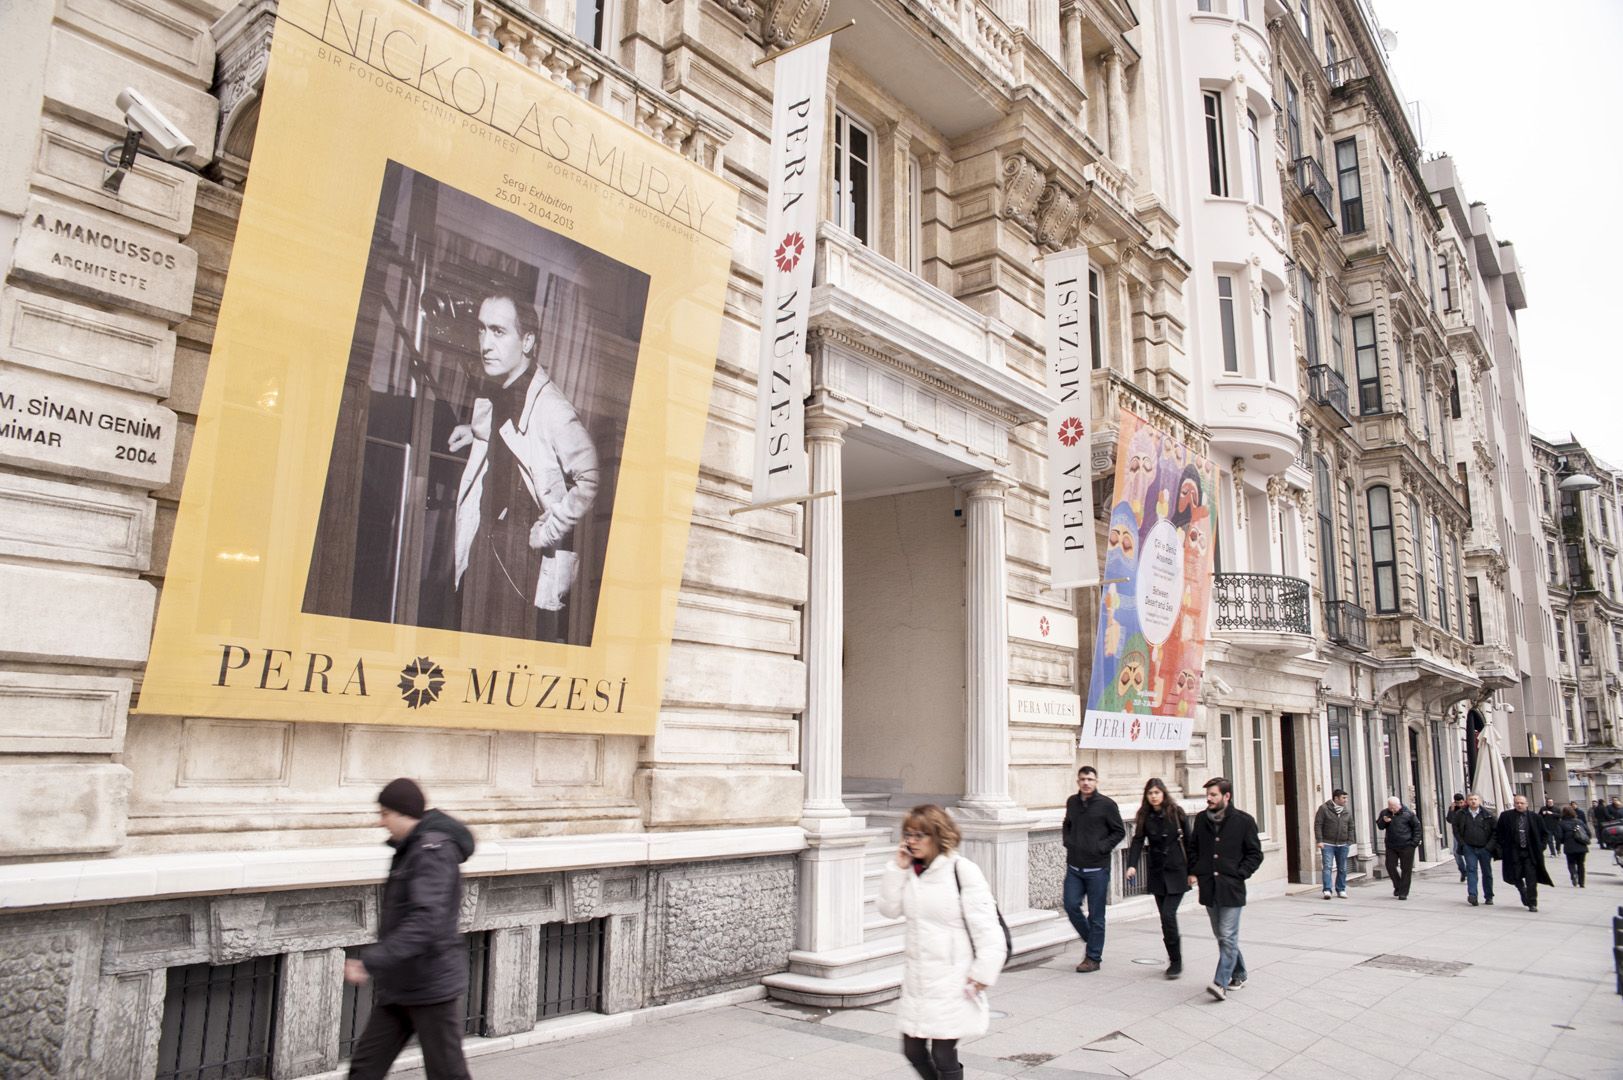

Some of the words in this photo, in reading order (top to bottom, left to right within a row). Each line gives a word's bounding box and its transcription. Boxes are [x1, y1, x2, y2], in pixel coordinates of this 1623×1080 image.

[322, 0, 572, 161] NICKOLAS
[586, 133, 714, 231] MURAY
[782, 97, 811, 214] PERA
[502, 173, 528, 192] Sergi
[529, 186, 573, 214] Exhibition
[546, 161, 598, 193] PORTRAIT
[602, 188, 615, 201] OF
[495, 188, 521, 206] 25.01
[528, 201, 575, 230] 21.04.2013
[51, 252, 147, 290] ARCHITECTE
[1054, 277, 1080, 403] MÜZESİ
[767, 289, 800, 475] MÜZESİ
[98, 413, 161, 440] GENİM
[116, 446, 157, 465] 2004
[1062, 463, 1085, 552] PERA
[212, 644, 371, 697] PERA
[462, 664, 629, 713] MÜZESİ
[1017, 699, 1040, 714] PERA
[1094, 718, 1125, 738] PERA
